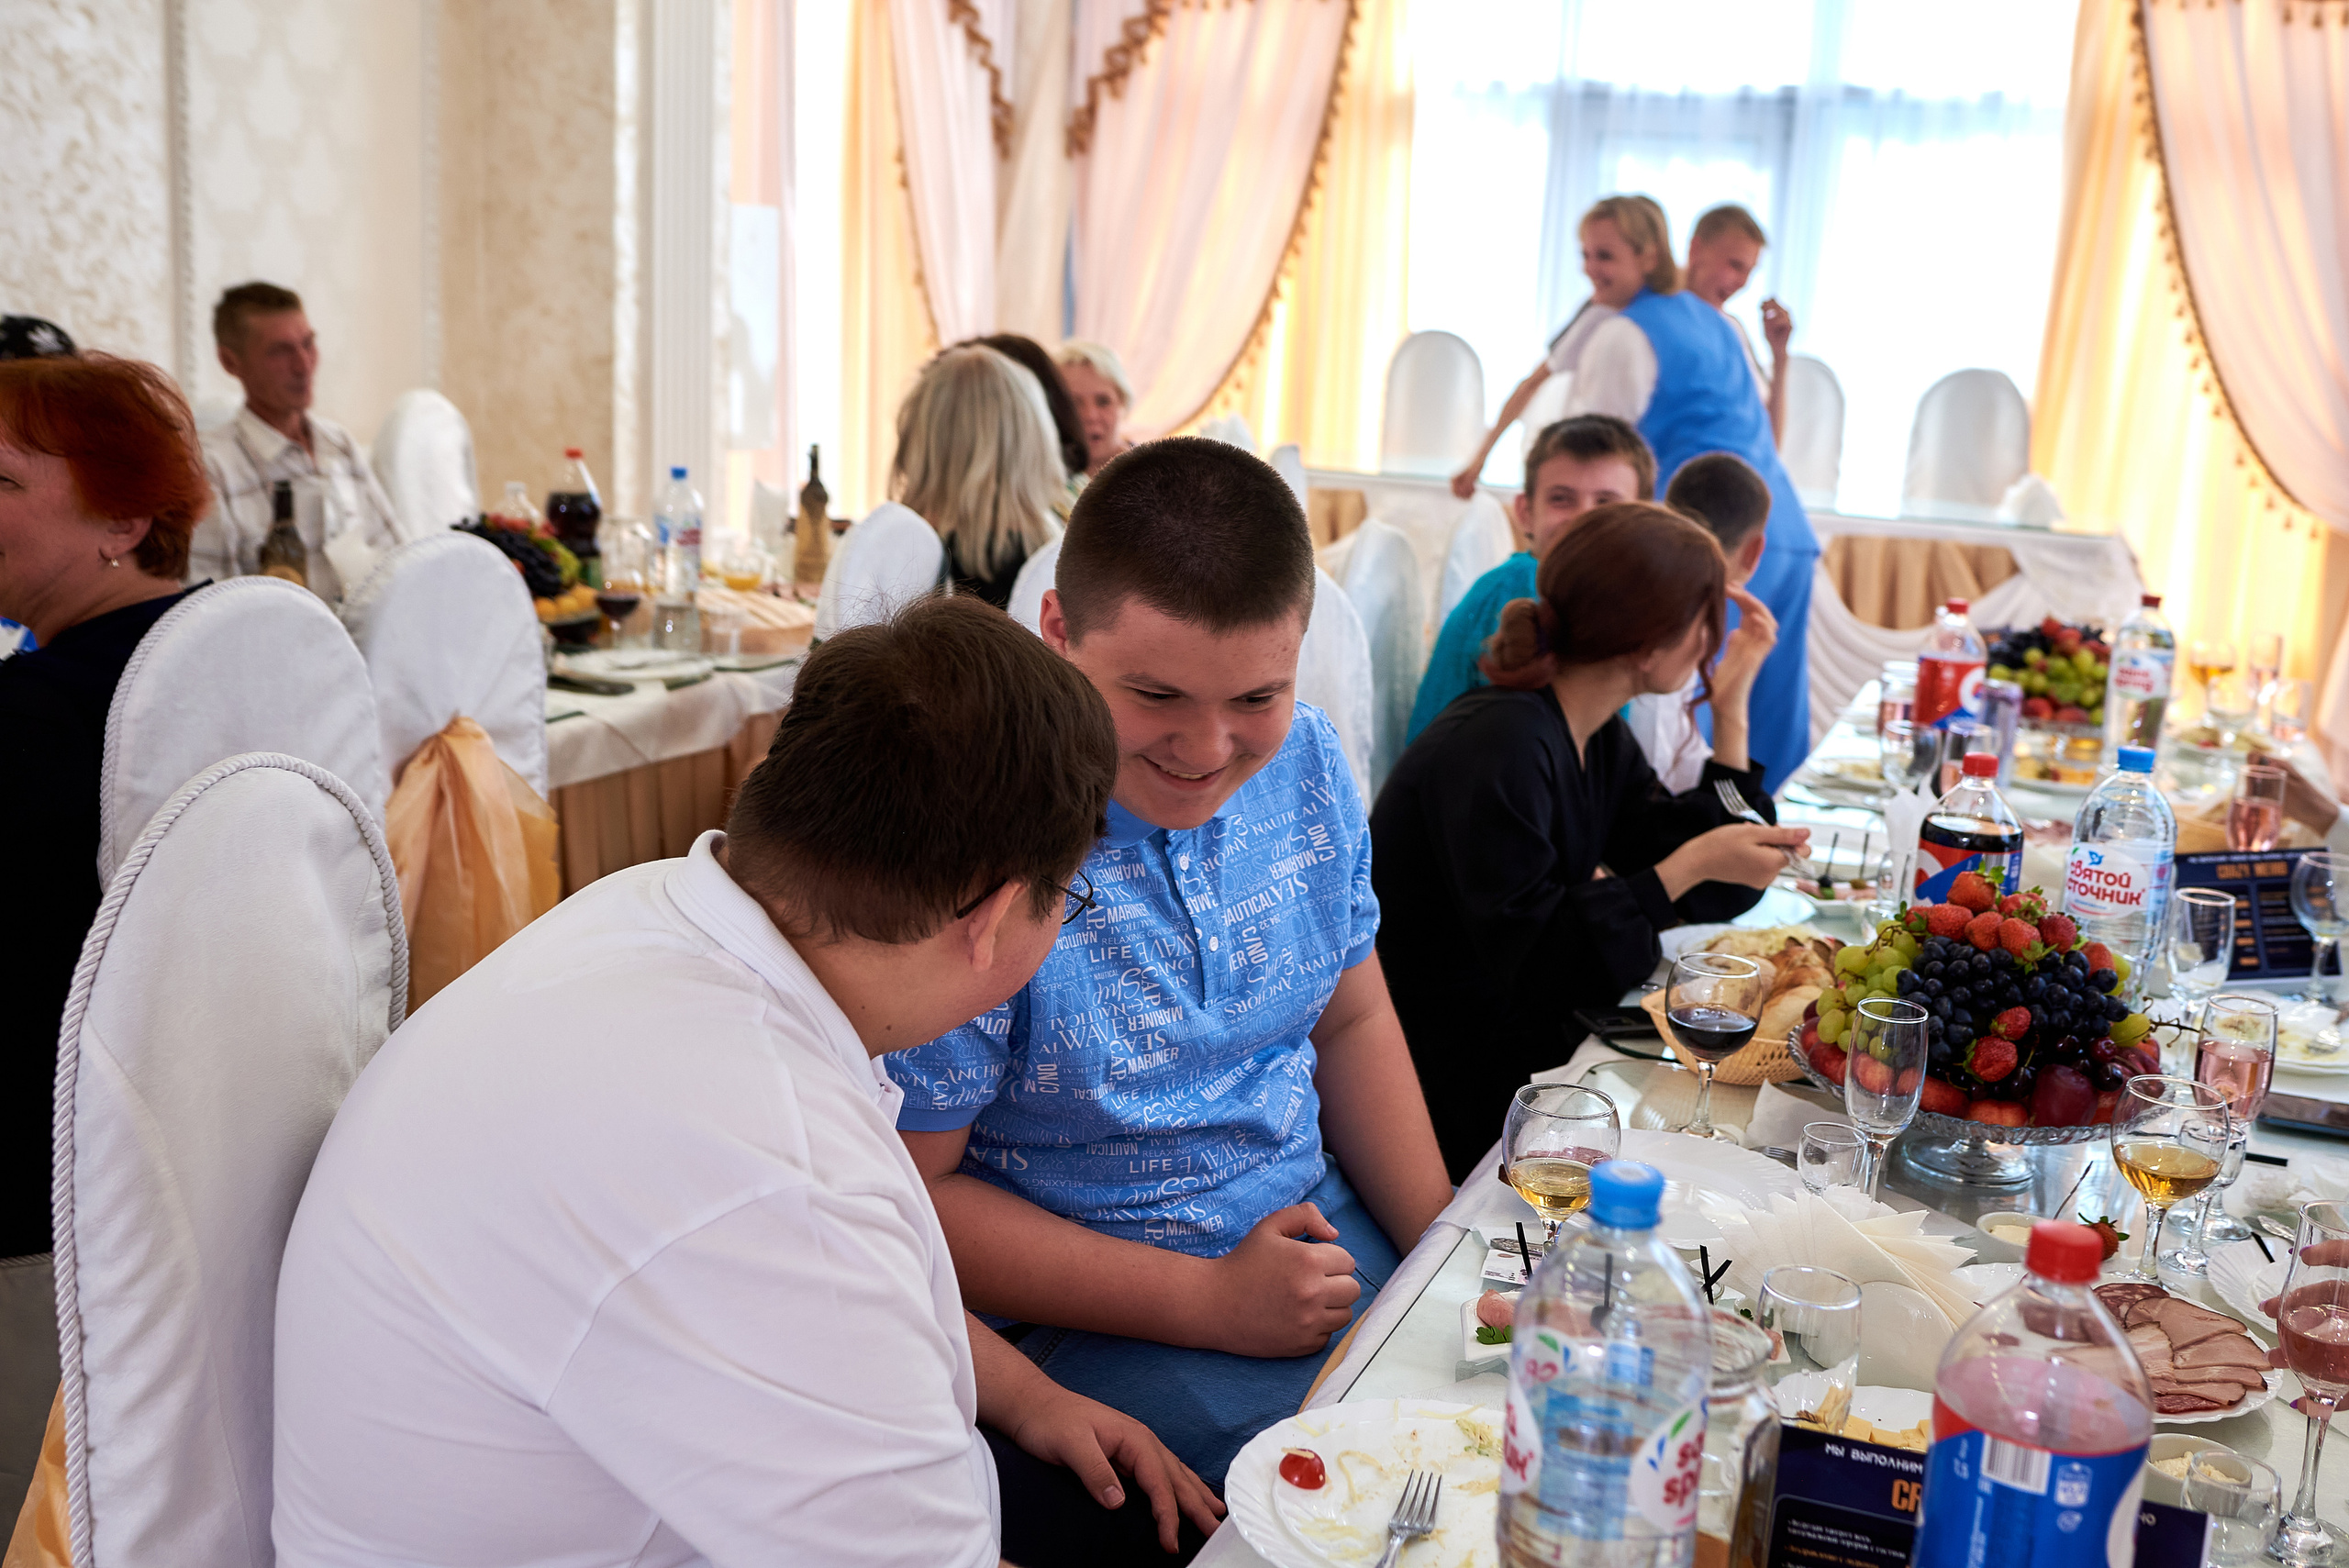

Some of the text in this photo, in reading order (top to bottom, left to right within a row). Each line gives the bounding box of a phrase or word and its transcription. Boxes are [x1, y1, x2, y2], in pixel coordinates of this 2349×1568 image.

[1250, 802, 1319, 837] NAUTICAL
[1271, 825, 1307, 860] Ship
[1308, 824, 1336, 862] C/NO
[1268, 849, 1319, 880] MARINER
[1269, 871, 1308, 903] SEA
[1107, 902, 1151, 924] MARINER
[1102, 930, 1145, 946] RELAXING
[1135, 932, 1197, 965] WAVE
[1241, 925, 1268, 965] C/NO
[1089, 944, 1133, 963] LIFE
[1092, 966, 1141, 1007] Ship
[1141, 965, 1161, 1009] CAP.
[1167, 973, 1189, 989] SEA
[1224, 976, 1293, 1018] ANCHORS
[1047, 1001, 1130, 1030] NAUTICAL
[1128, 1005, 1184, 1031] MARINER
[1058, 1016, 1128, 1051] WAVE
[1122, 1028, 1168, 1054] SEA
[1108, 1040, 1127, 1081] CAP.
[1127, 1046, 1180, 1075] MARINER
[1037, 1063, 1060, 1094] C/NO
[1071, 1082, 1117, 1101] NAUTICAL
[1199, 1064, 1249, 1103] MARINER
[1111, 1087, 1141, 1109] LIFE
[969, 1146, 1029, 1171] SEA
[1142, 1130, 1230, 1158] RELAXING ON BOARD
[1176, 1140, 1240, 1174] WAVE
[1130, 1158, 1173, 1173] LIFE
[1031, 1178, 1084, 1188] RELAXING
[1166, 1214, 1225, 1237] MARINER
